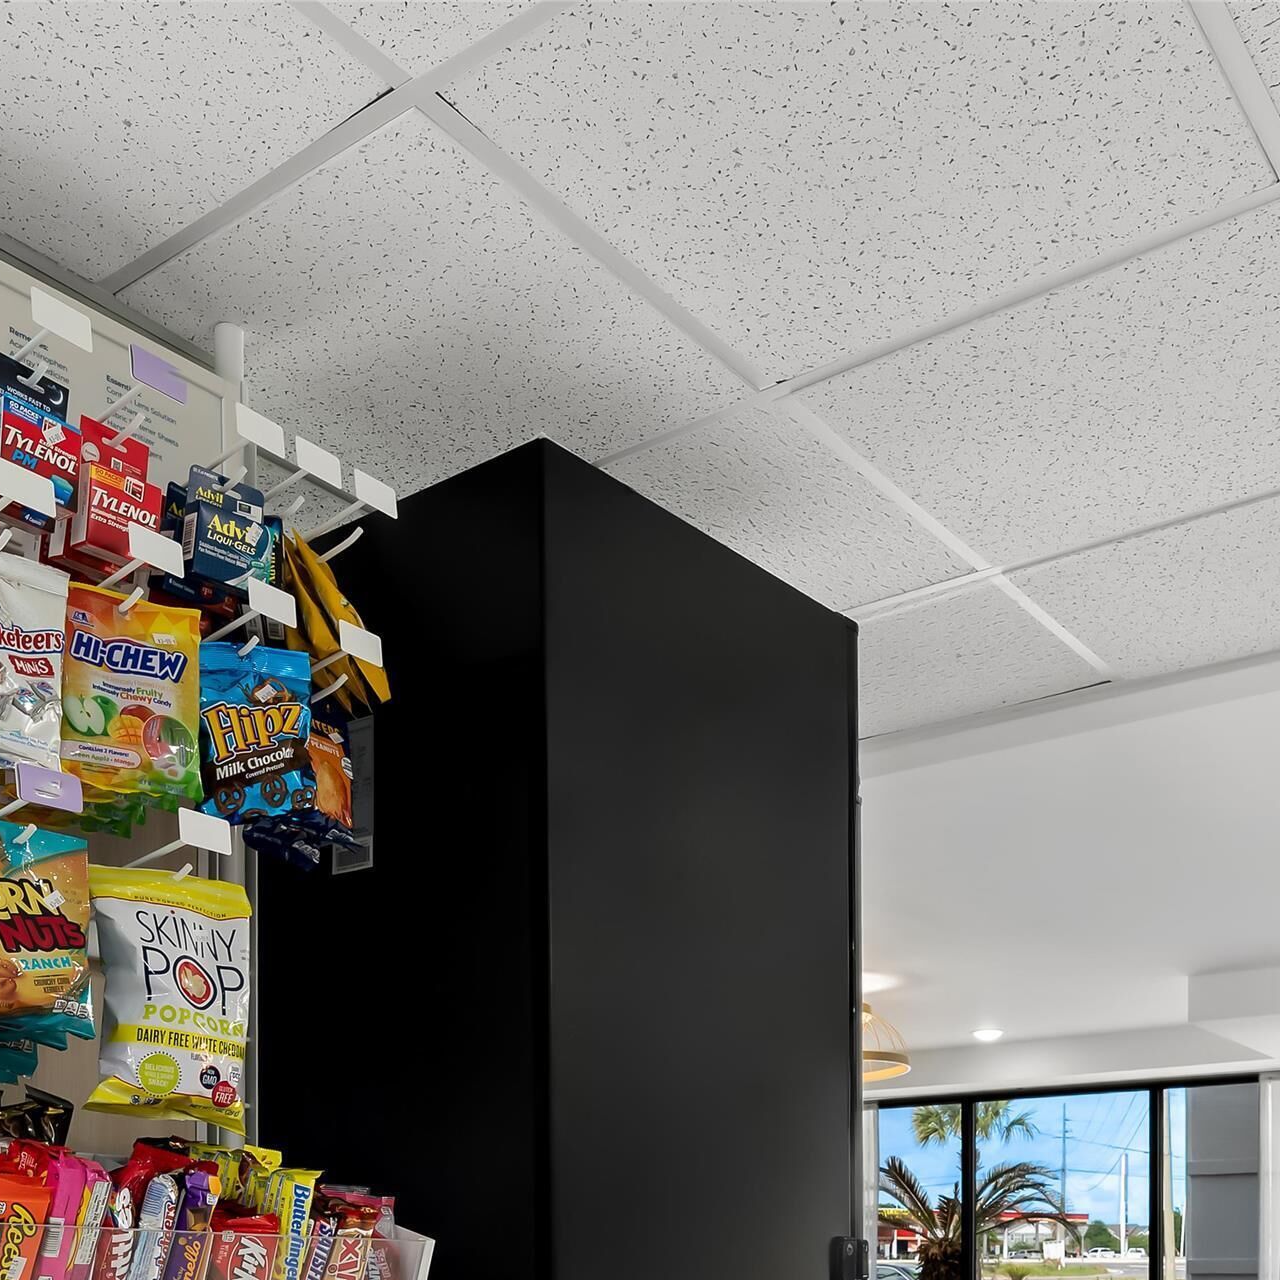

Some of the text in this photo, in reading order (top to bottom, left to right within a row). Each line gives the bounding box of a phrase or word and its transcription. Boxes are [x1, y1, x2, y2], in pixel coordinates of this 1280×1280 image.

[6, 385, 51, 412] WORKS FAST TO
[9, 400, 19, 409] GO
[19, 404, 42, 418] PACKS
[4, 424, 77, 476] TYLENOL
[12, 449, 39, 470] PM
[95, 467, 104, 475] GO
[196, 486, 223, 503] Advil
[90, 512, 107, 524] Extra
[91, 486, 158, 528] TYLENOL
[207, 530, 256, 555] LIQUI-GELS
[72, 630, 184, 681] HI-CHEW
[119, 692, 153, 704] Chewy
[153, 698, 172, 708] Candy
[136, 687, 163, 699] Fruity
[204, 703, 301, 762] Flipz
[216, 747, 295, 781] Milk Chocolate
[245, 768, 265, 779] Covered
[135, 910, 236, 962] SKINNY
[17, 956, 72, 970] RANCH
[142, 945, 245, 1016] POP
[142, 1004, 244, 1038] POPCORN
[136, 1027, 217, 1053] DAIRY FREE WHITE
[202, 1074, 217, 1085] GMO
[215, 1092, 234, 1105] FREE
